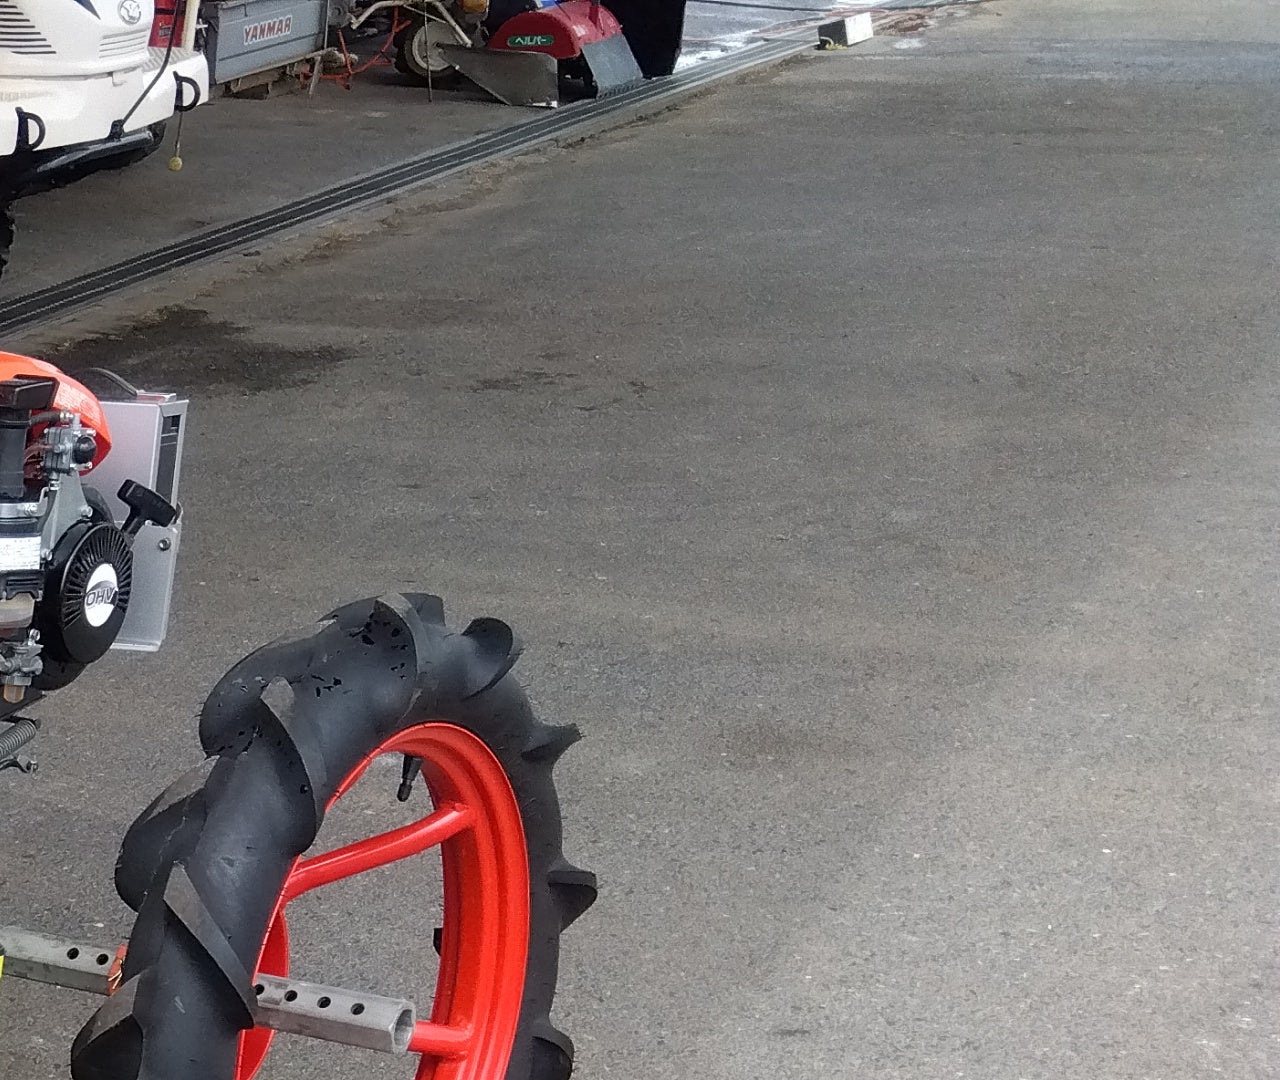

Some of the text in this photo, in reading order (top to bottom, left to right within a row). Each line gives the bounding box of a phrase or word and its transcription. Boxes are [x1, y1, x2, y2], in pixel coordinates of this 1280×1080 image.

[243, 15, 292, 45] YANMAR
[514, 35, 548, 46] ヘルパー
[85, 586, 117, 607] OHV
